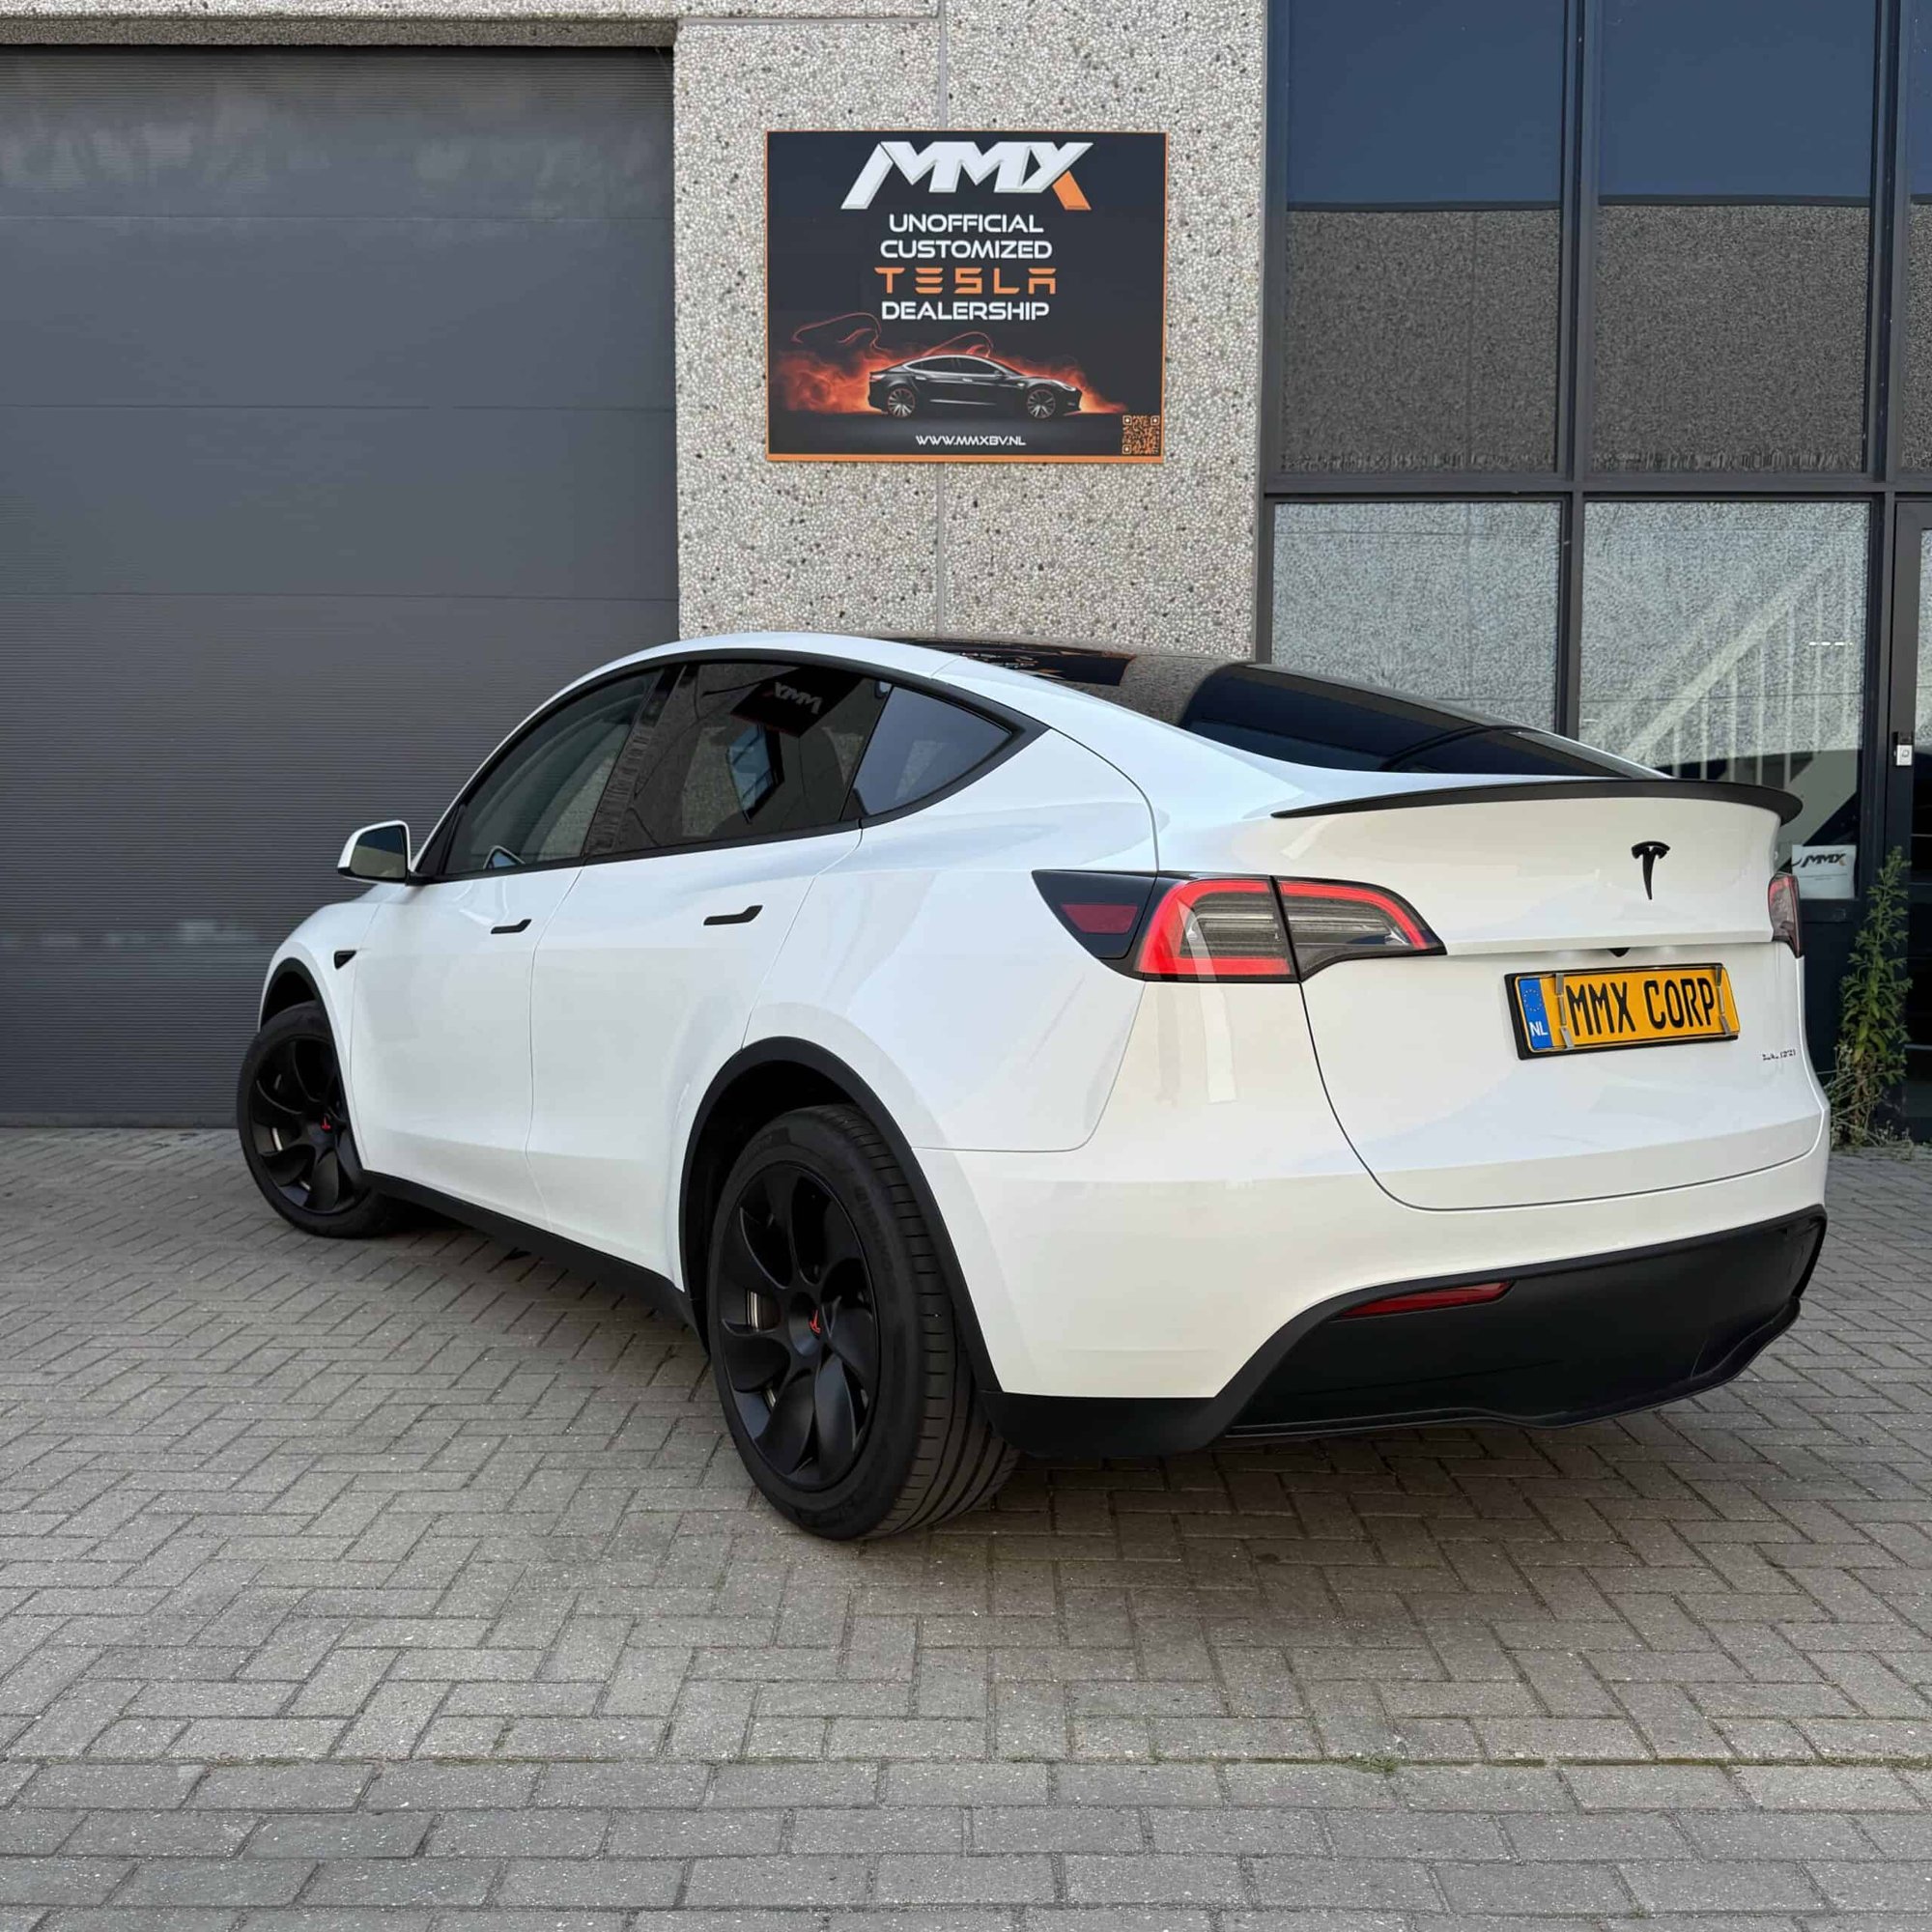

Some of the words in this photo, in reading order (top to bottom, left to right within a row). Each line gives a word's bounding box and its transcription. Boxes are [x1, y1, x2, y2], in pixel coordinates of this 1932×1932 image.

[840, 140, 1094, 211] MMX
[889, 213, 1044, 234] UNOFFICIAL
[880, 239, 1053, 259] CUSTOMIZED
[874, 267, 1057, 295] TESLA
[881, 300, 1050, 321] DEALERSHIP
[915, 435, 1027, 446] WWW.MMXBV.NL
[1800, 853, 1847, 867] MMX
[1566, 981, 1636, 1037] MMX
[1644, 978, 1716, 1030] CORP
[1529, 1021, 1548, 1037] NL
